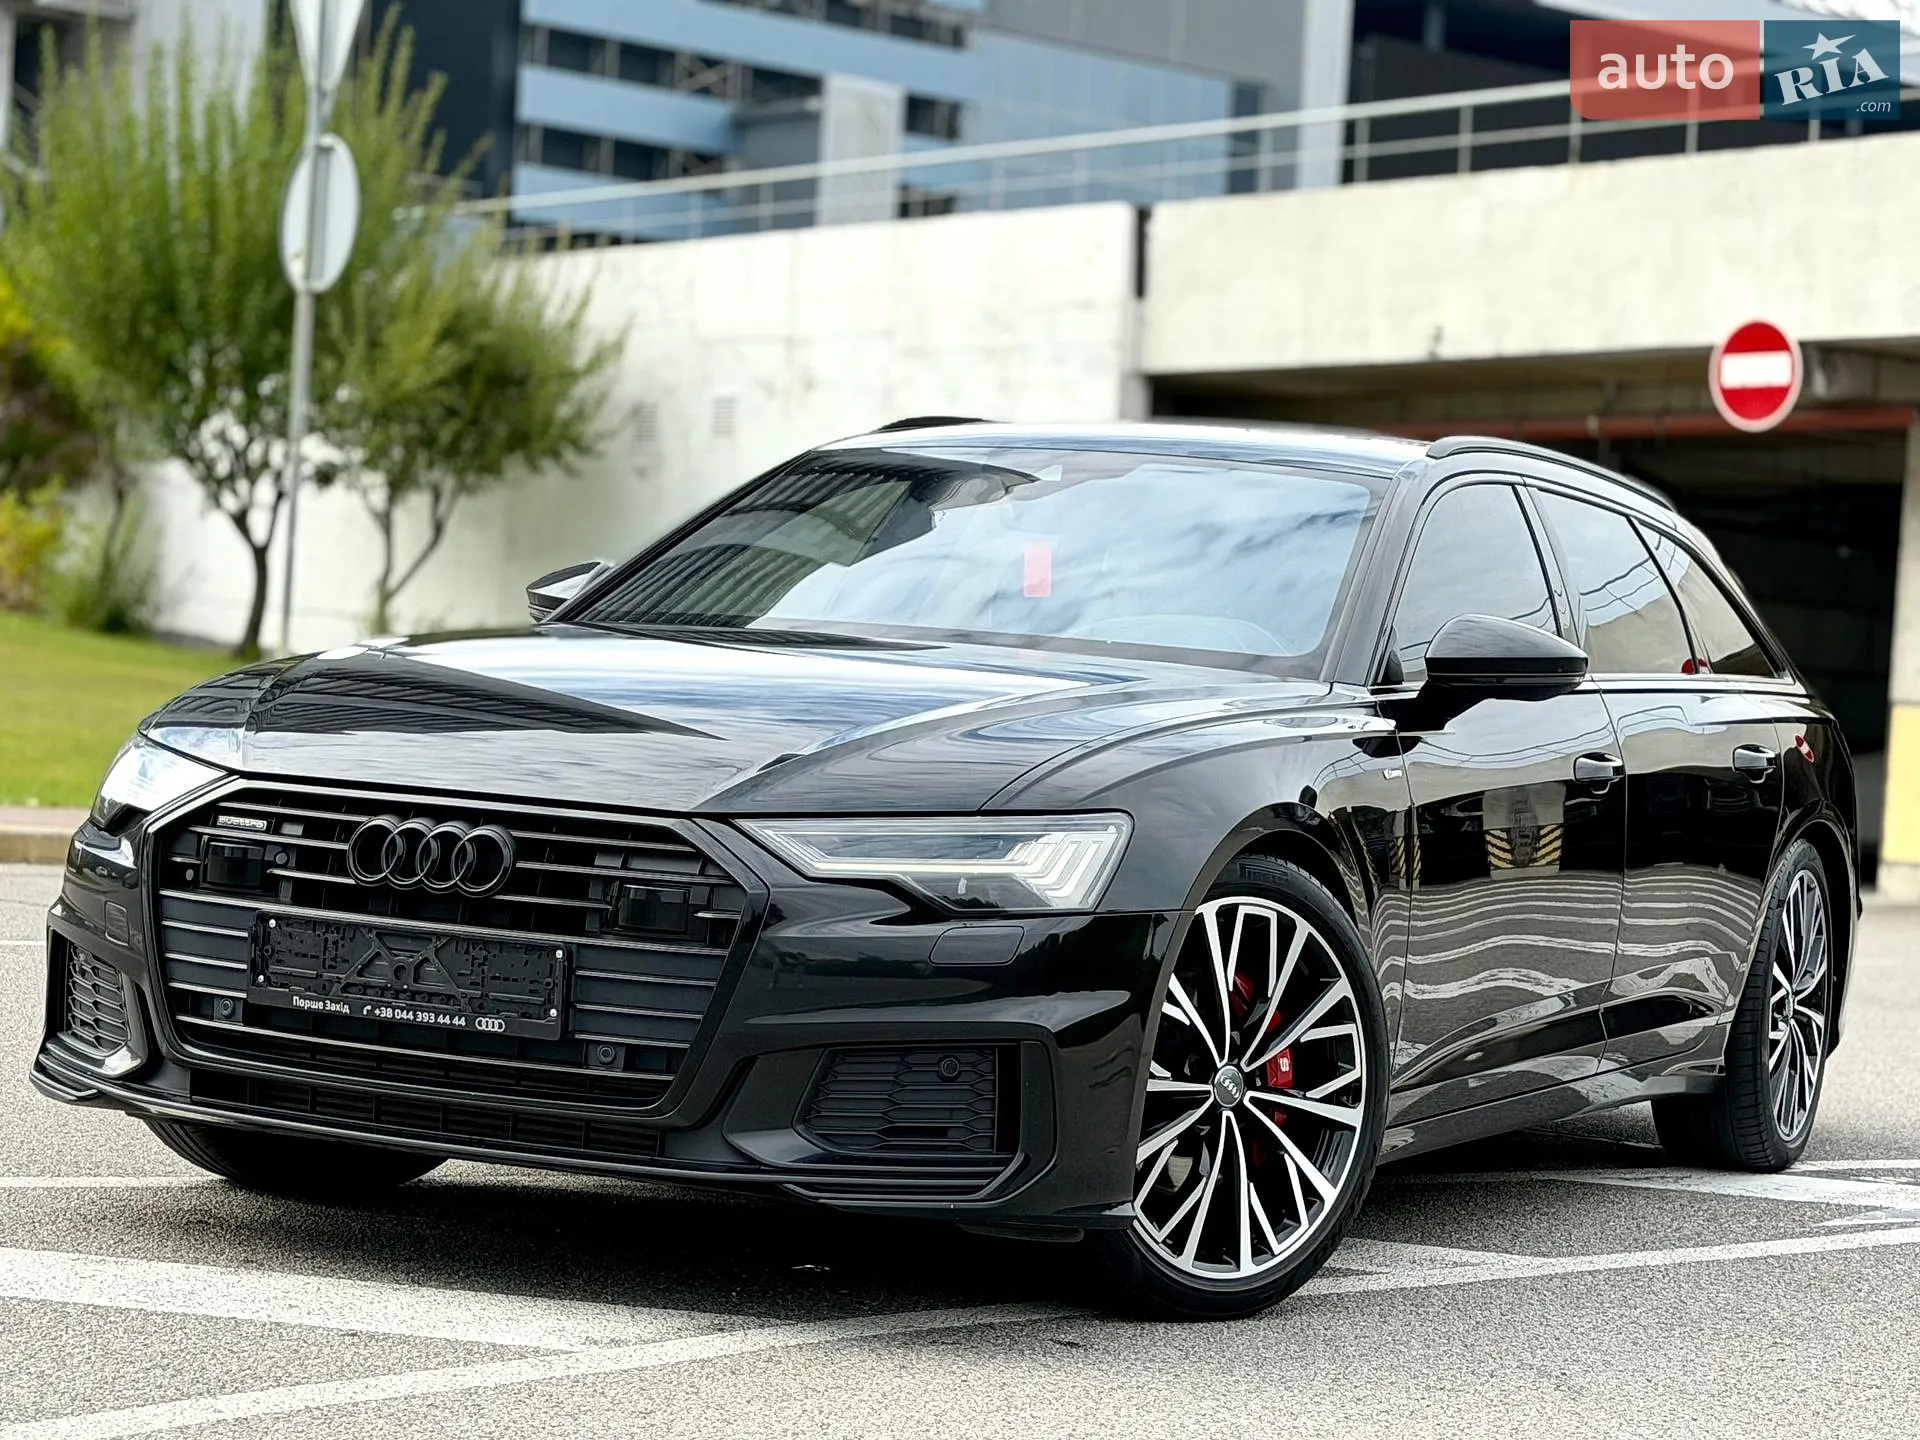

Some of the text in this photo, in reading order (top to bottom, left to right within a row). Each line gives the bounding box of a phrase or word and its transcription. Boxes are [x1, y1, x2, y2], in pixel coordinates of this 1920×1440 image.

[293, 996, 350, 1014] Порше Захід
[374, 1007, 466, 1027] +38 044 393 44 44
